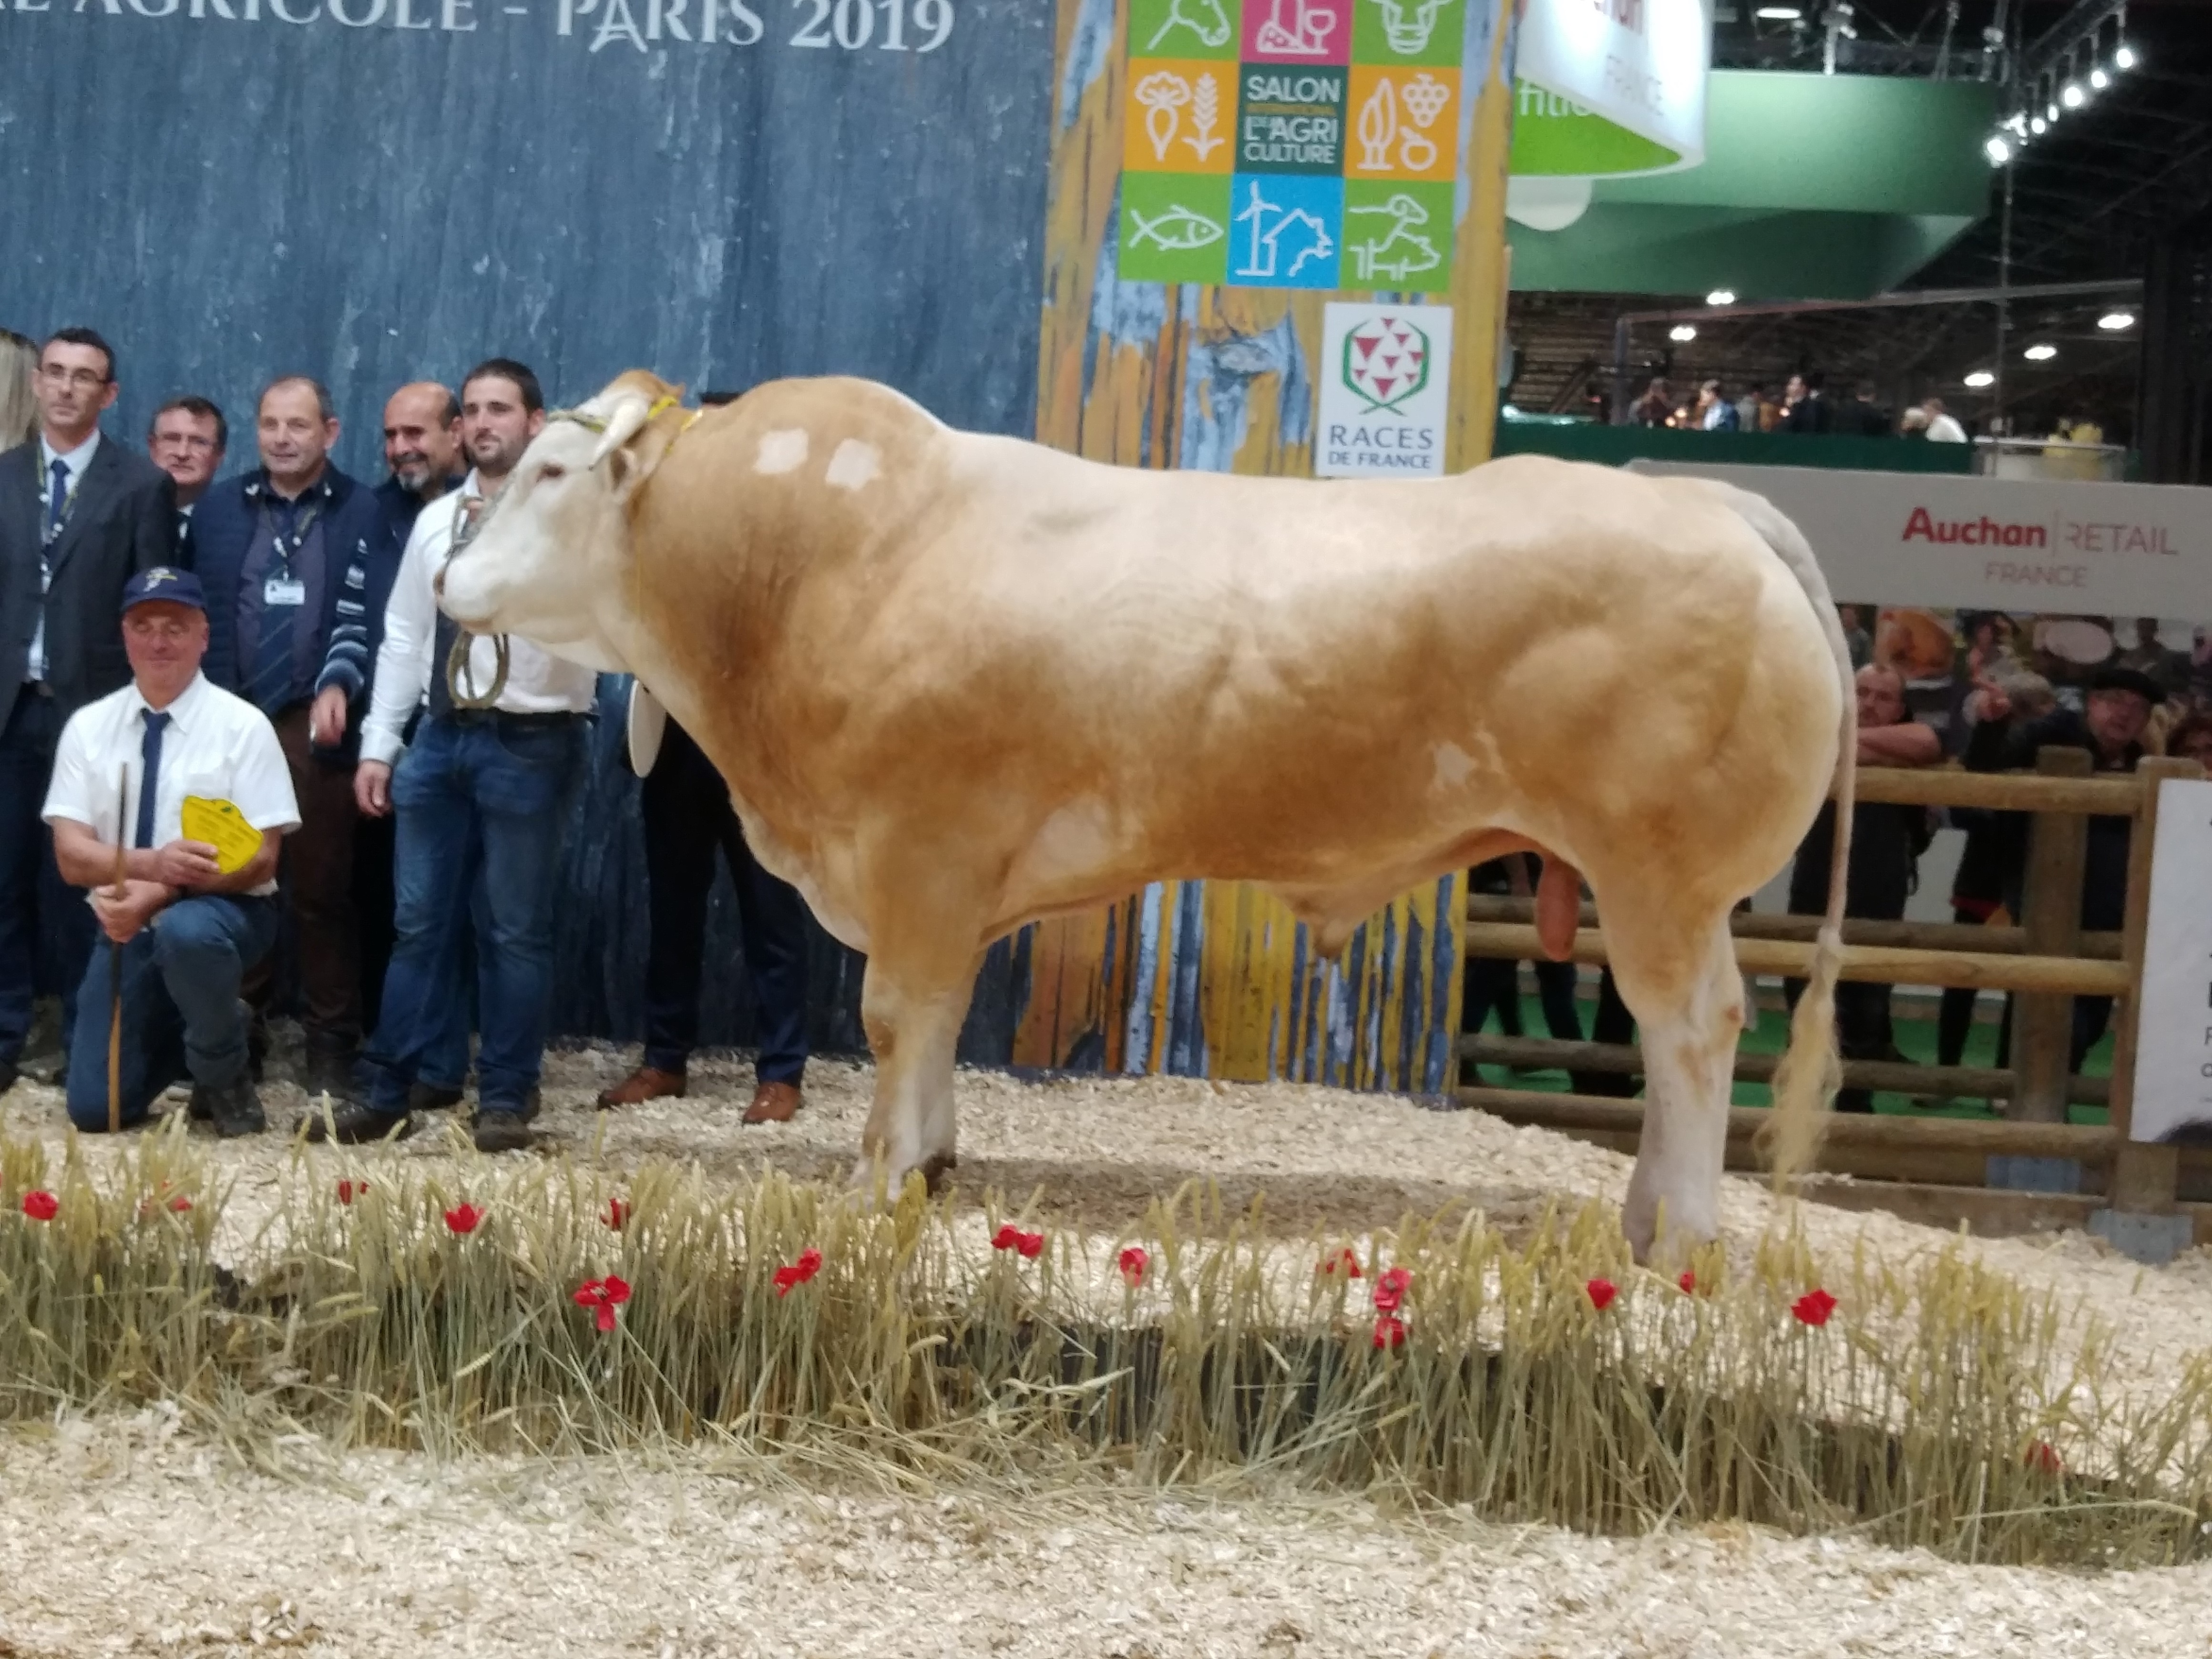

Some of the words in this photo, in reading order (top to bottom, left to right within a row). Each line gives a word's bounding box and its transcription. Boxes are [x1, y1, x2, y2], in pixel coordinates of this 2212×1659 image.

[557, 0, 763, 52] PARIS
[789, 0, 954, 52] 2019
[1247, 75, 1341, 102] SALON
[1243, 143, 1336, 164] CULTURE
[1329, 424, 1434, 449] RACES
[1327, 451, 1351, 466] DE
[1358, 452, 1431, 469] FRANCE
[1901, 506, 2048, 548] Auchan
[2065, 522, 2180, 555] RETAIL
[1984, 560, 2088, 587] FRANCE
